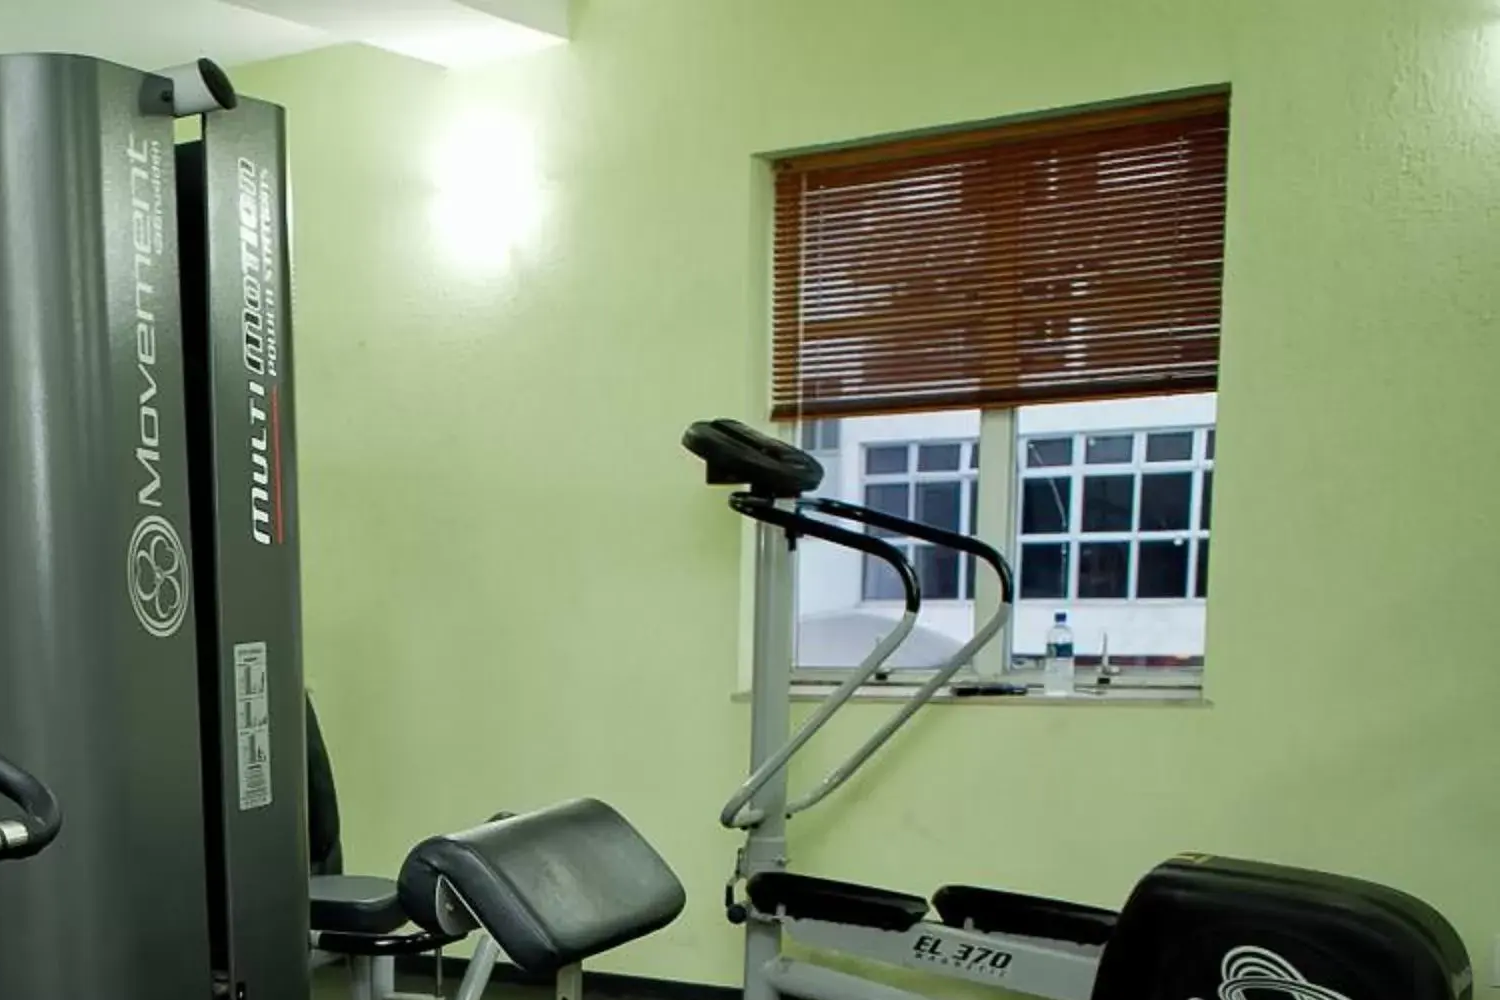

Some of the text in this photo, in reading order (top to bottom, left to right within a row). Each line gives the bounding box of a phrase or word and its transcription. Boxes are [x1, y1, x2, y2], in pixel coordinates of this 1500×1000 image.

[127, 133, 163, 507] Movement
[238, 157, 271, 545] MULTI MOTION
[264, 290, 277, 377] POWER
[913, 935, 1013, 969] EL 370
